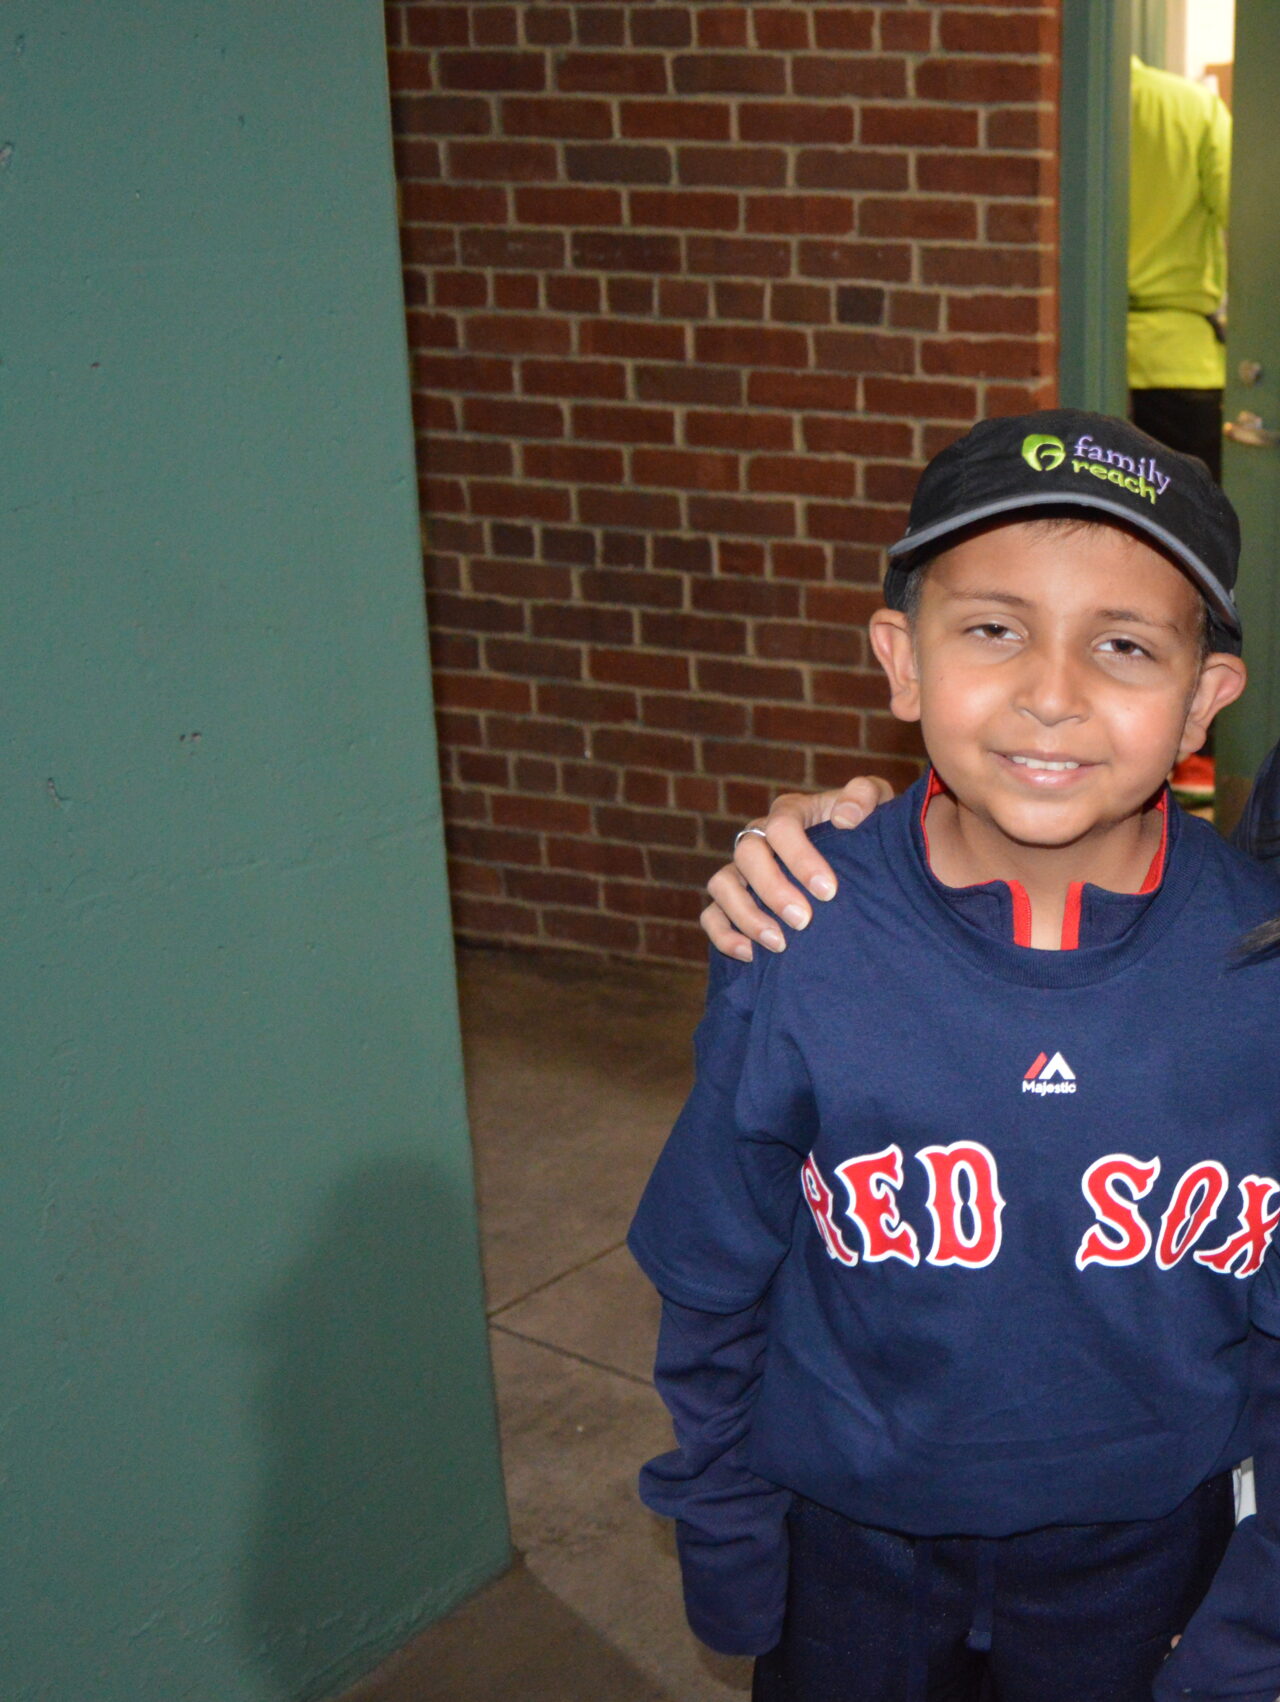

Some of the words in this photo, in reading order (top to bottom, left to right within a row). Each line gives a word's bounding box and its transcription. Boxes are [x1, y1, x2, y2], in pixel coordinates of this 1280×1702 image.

[1072, 459, 1156, 504] reach
[1073, 435, 1171, 494] family
[1022, 1080, 1077, 1096] Majestic
[801, 1140, 1007, 1269] RED
